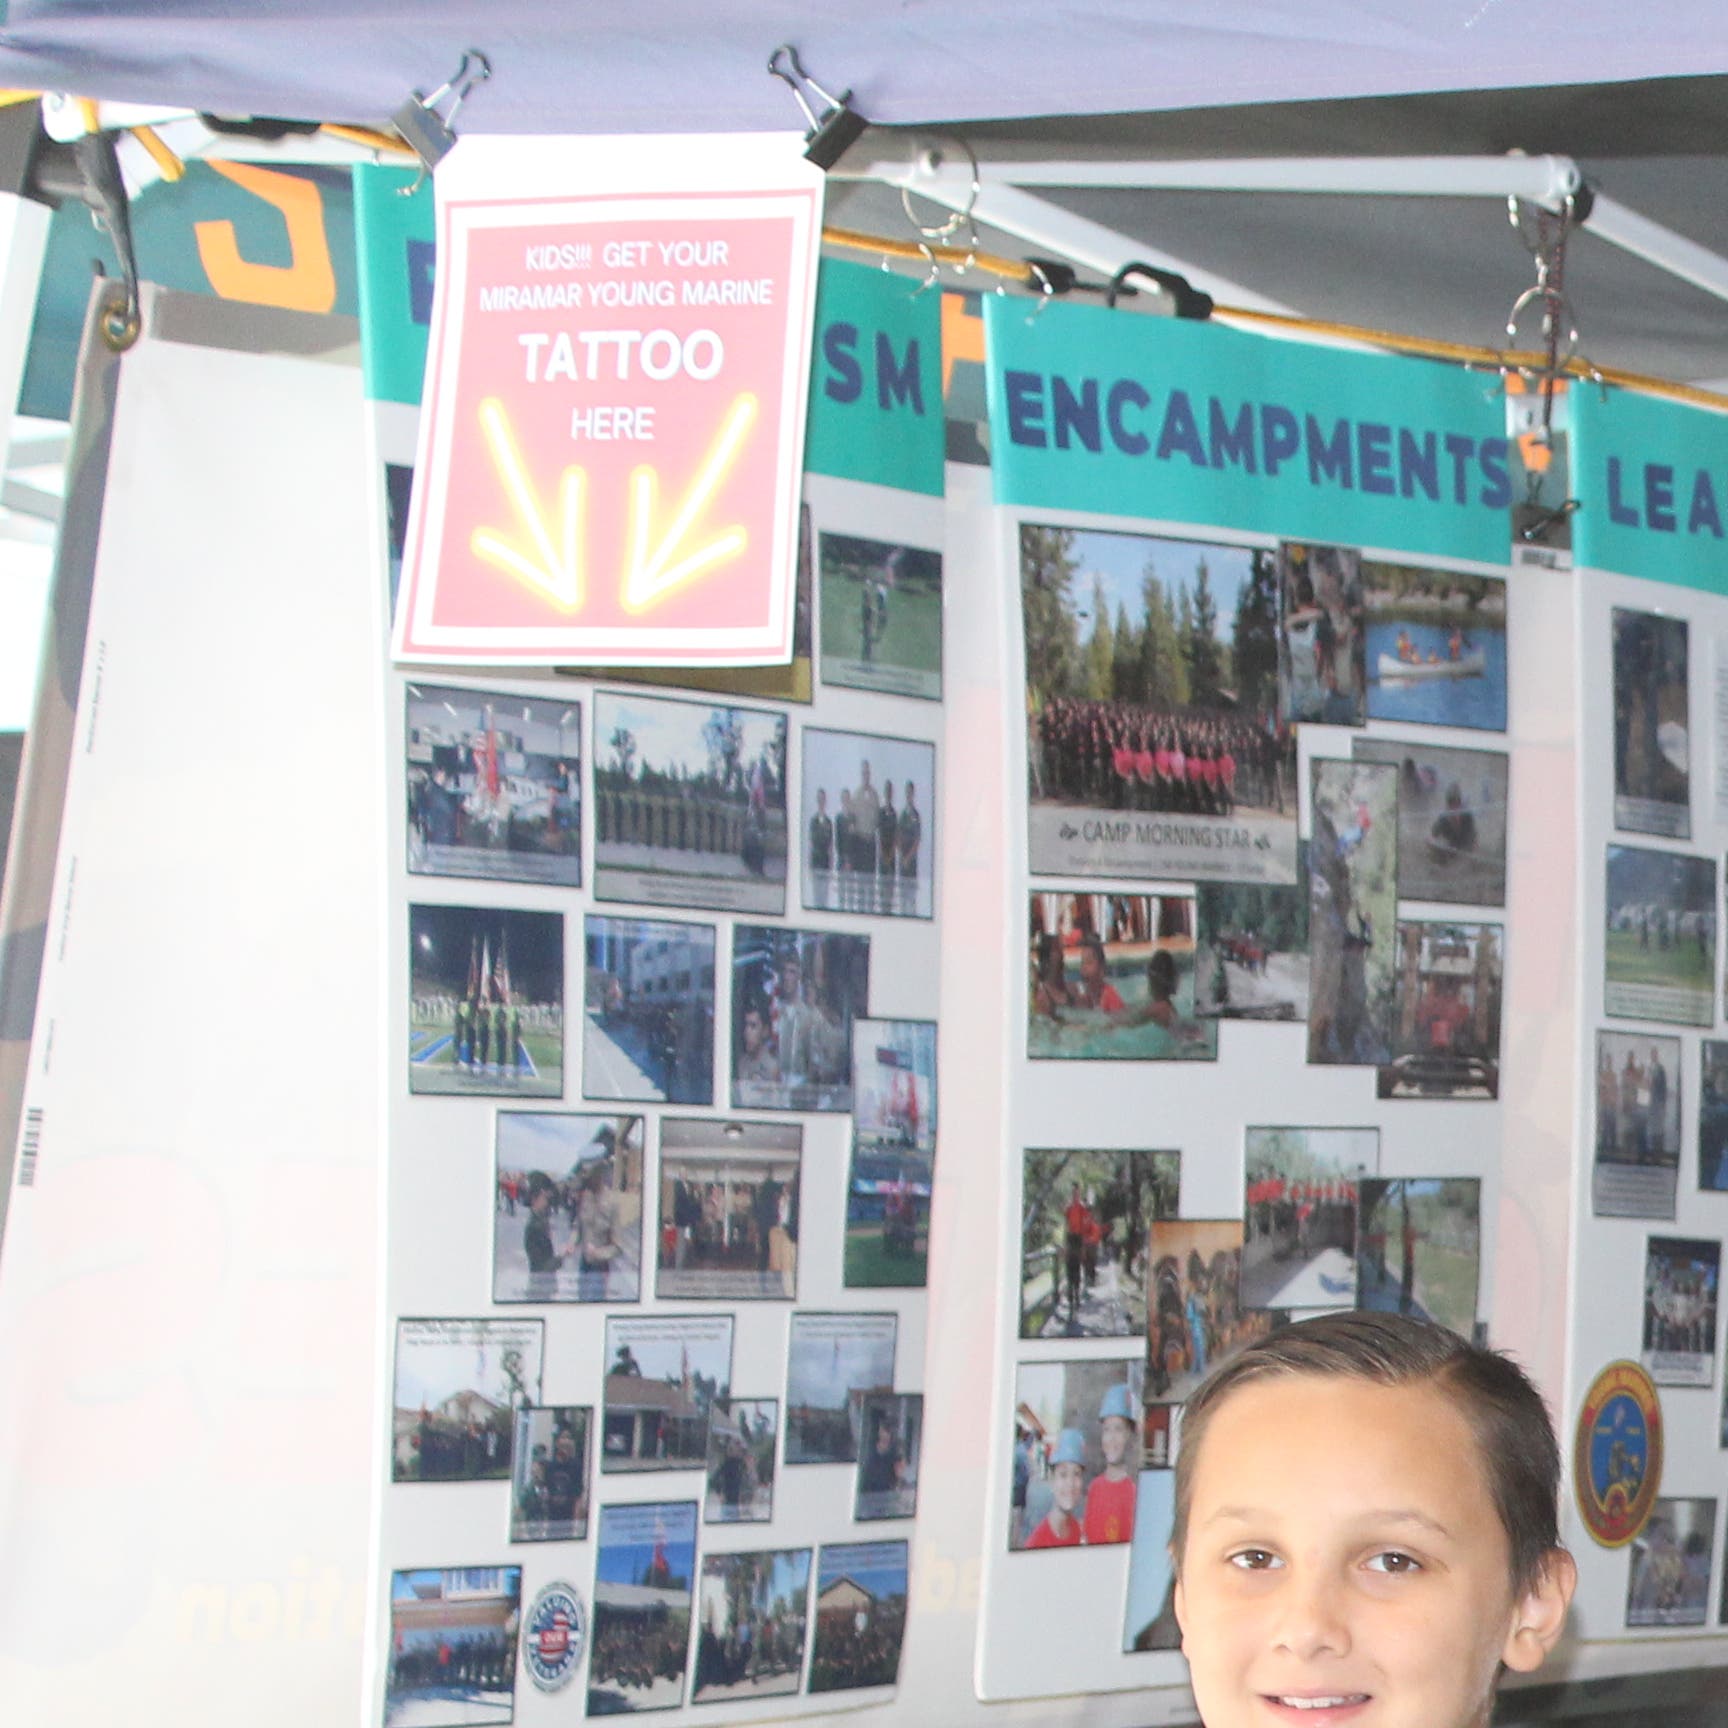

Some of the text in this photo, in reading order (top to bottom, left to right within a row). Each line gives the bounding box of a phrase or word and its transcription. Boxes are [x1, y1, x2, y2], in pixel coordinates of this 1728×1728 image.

[525, 240, 729, 272] KIDS!!! GET YOUR
[479, 279, 775, 312] MIRAMAR YOUNG MARINE
[518, 328, 725, 383] TATTOO
[570, 407, 656, 441] HERE
[1003, 369, 1513, 508] ENCAMPMENTS
[1083, 821, 1250, 849] CAMP MORNING STAR
